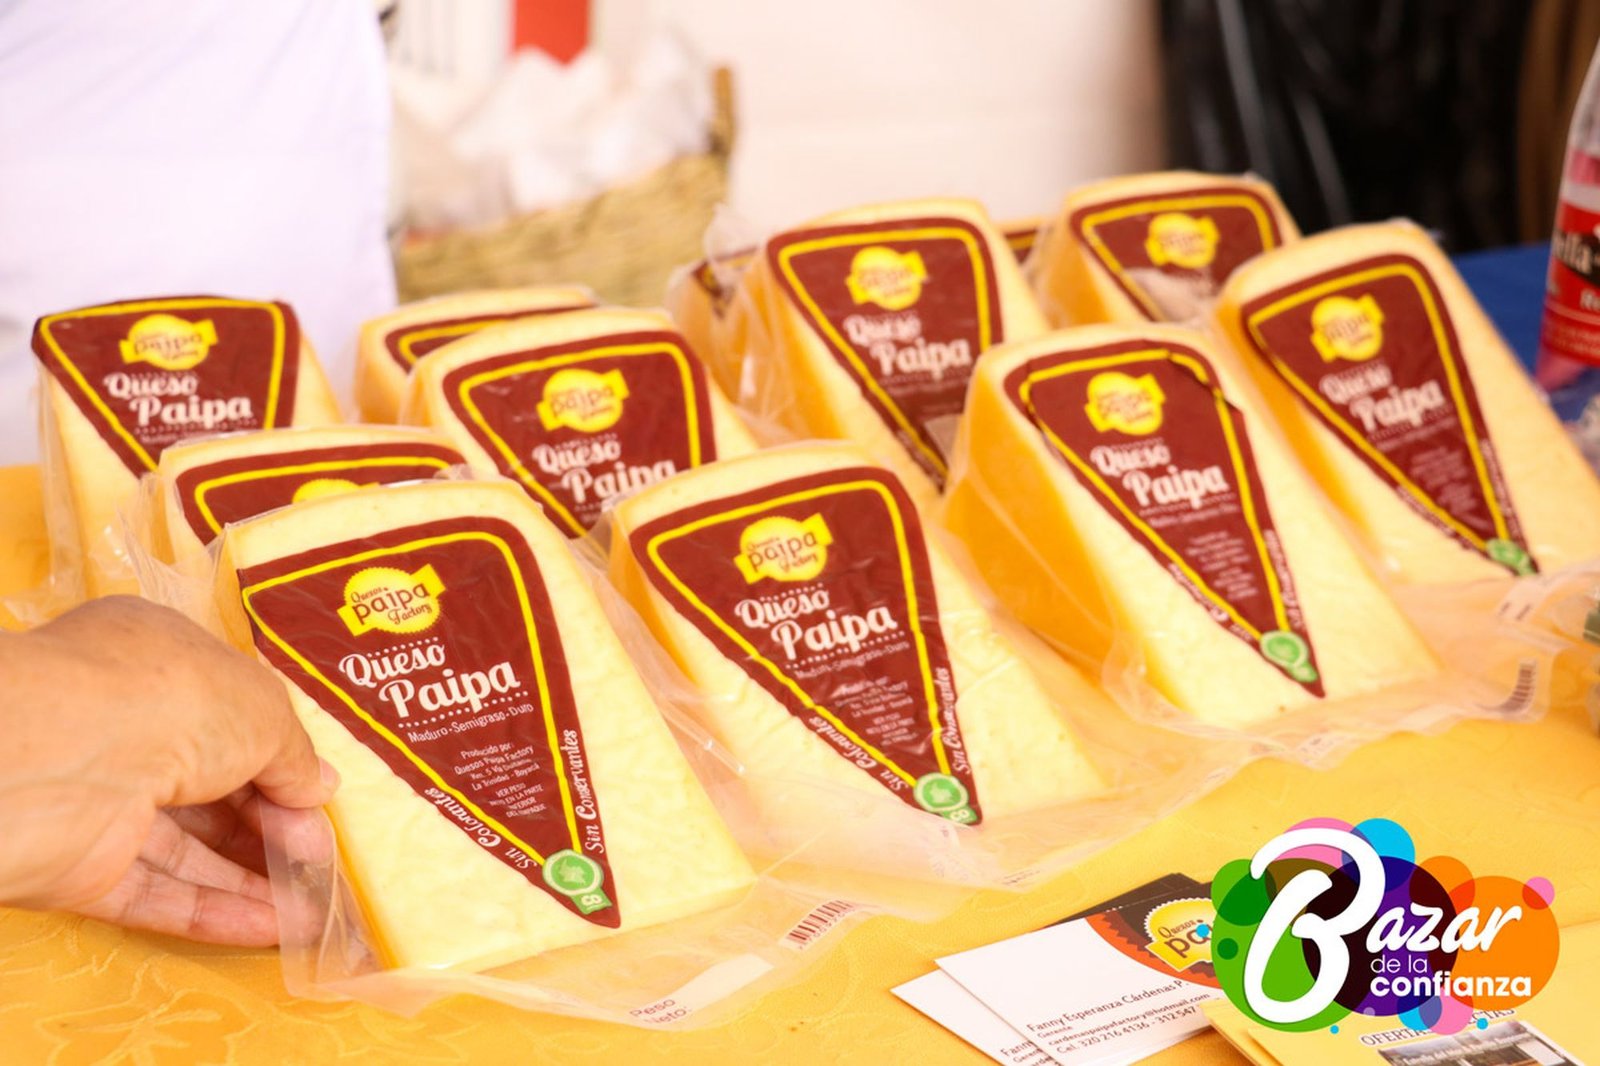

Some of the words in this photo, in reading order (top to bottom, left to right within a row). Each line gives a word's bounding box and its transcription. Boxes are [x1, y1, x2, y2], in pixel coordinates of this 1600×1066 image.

[869, 337, 973, 382] Paipa
[103, 372, 198, 400] Queso
[129, 394, 253, 429] Paipa
[1349, 380, 1445, 431] Paipa
[531, 440, 622, 476] Queso
[1090, 445, 1171, 477] Queso
[1122, 465, 1230, 508] Paipa
[748, 531, 818, 573] paipa
[352, 583, 430, 625] paipa
[387, 603, 433, 625] Factory
[734, 588, 829, 628] Queso
[770, 606, 897, 661] Paipa
[338, 643, 445, 688] Queso
[378, 661, 521, 718] Paipa
[454, 761, 485, 775] Quesos
[505, 746, 534, 761] Factory
[461, 745, 499, 759] Producido
[560, 729, 597, 820] Conservantes
[879, 769, 909, 791] Sin
[424, 787, 501, 847] Colorantes
[504, 847, 538, 869] Sin
[585, 824, 604, 854] Sin
[1157, 920, 1197, 939] Quesos
[629, 998, 676, 1017] Peso
[1026, 1015, 1065, 1033] Fanny
[1062, 999, 1123, 1022] Esperanza
[1121, 982, 1177, 1004] Cárdenas
[1000, 1039, 1034, 1057] Fann
[1056, 1043, 1081, 1054] Cel.
[1079, 1034, 1102, 1048] 320
[1102, 1028, 1123, 1042] 216
[1122, 1020, 1151, 1037] 4136
[1157, 1012, 1177, 1025] 312
[1176, 1004, 1197, 1018] 547
